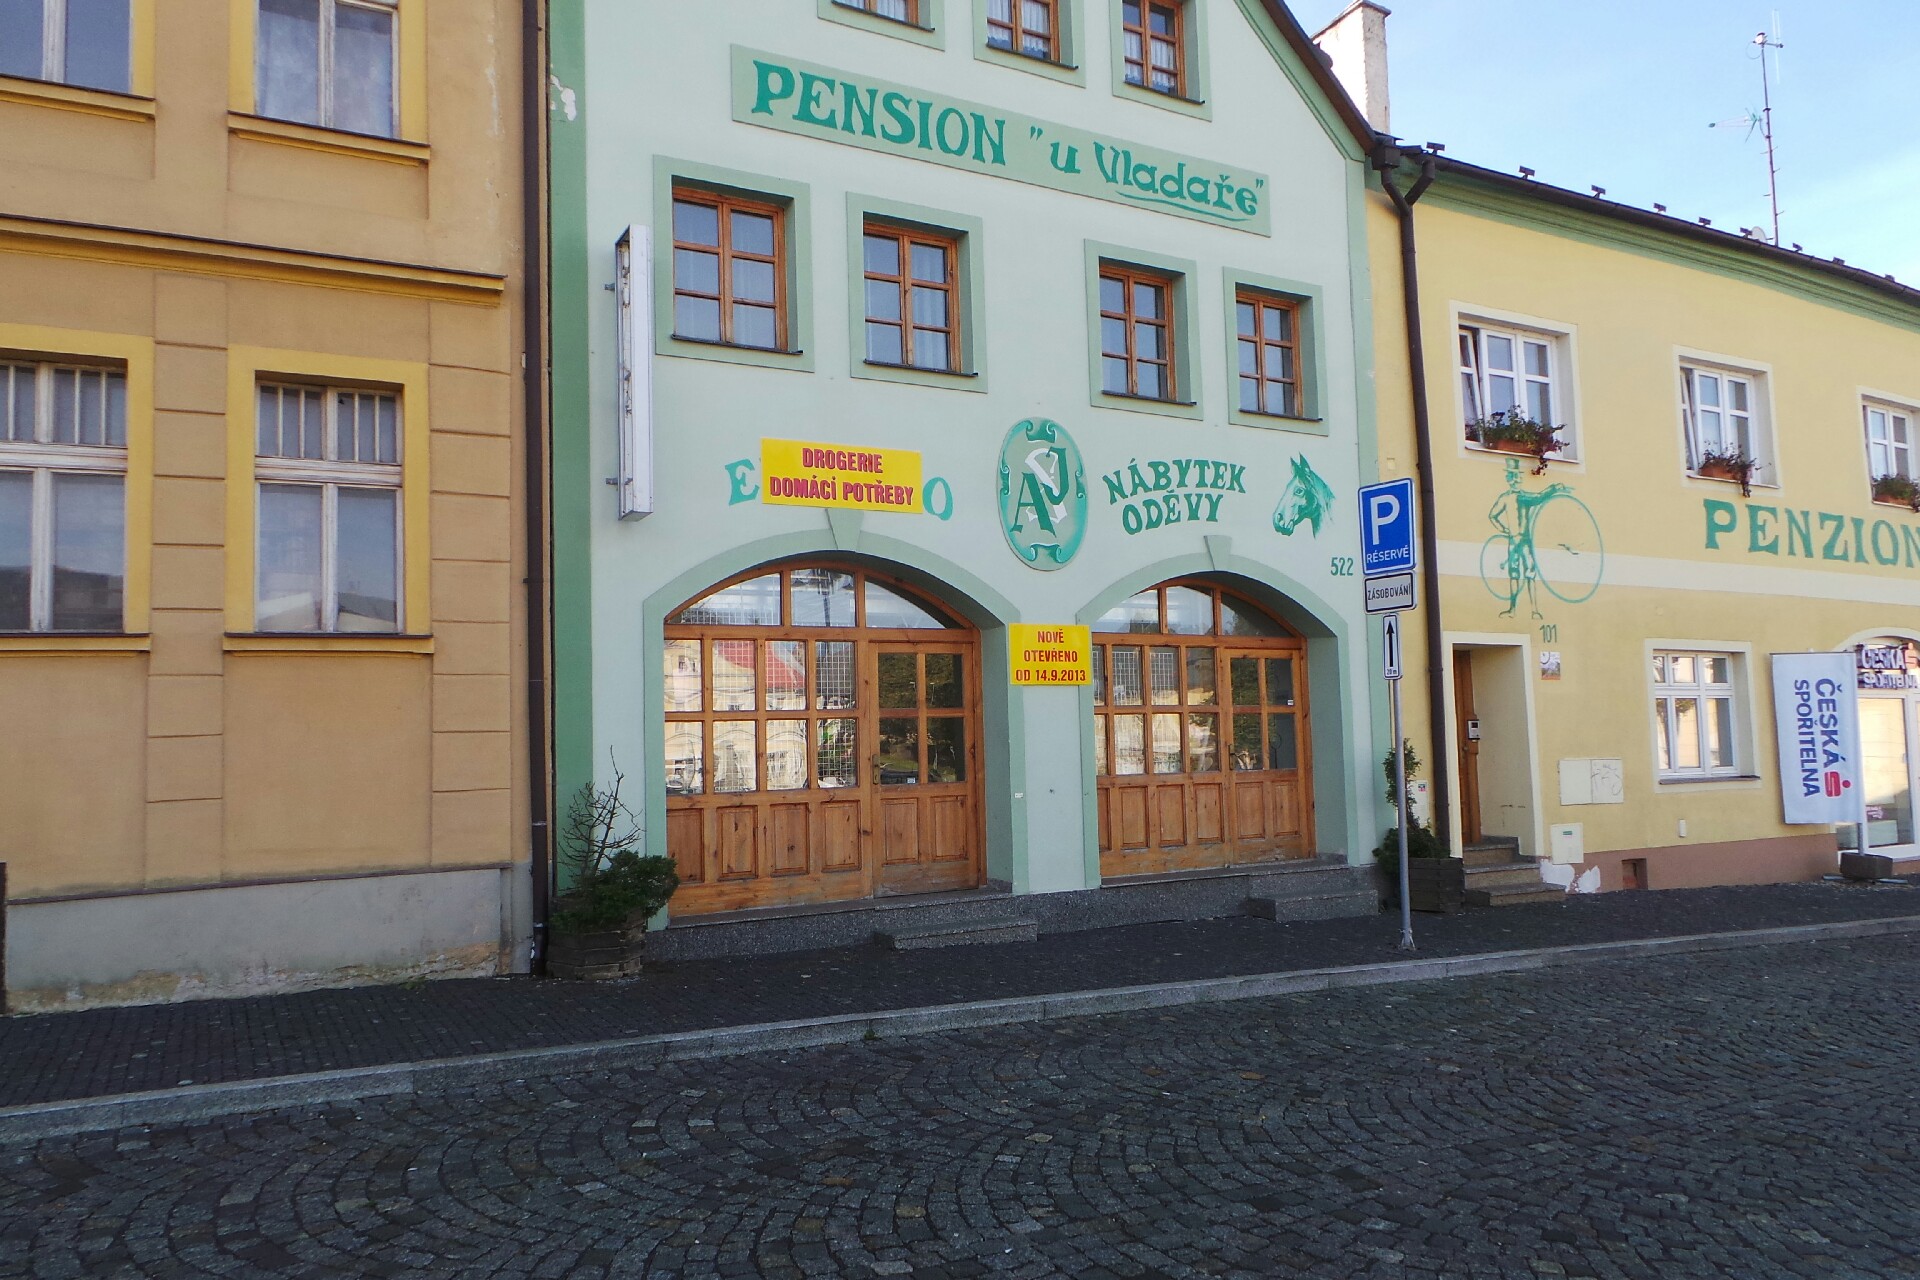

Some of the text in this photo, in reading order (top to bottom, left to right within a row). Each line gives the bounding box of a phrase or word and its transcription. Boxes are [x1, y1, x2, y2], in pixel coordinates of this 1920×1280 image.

[752, 60, 1006, 165] PENSION
[802, 447, 883, 474] DROGERIE
[769, 475, 914, 505] DOMÁCÍ POTŘEBY
[1101, 458, 1247, 505] NÁBYTEK
[1121, 491, 1224, 536] ODĚVY
[1370, 494, 1400, 546] P
[1703, 498, 1920, 569] PENZION
[1330, 557, 1354, 577] 522
[1366, 545, 1410, 563] RÉSERVÉ
[1367, 583, 1411, 601] ZÁSOBOVÁNÍ
[1037, 628, 1065, 643] NOVĚ
[1539, 624, 1558, 644] 101
[1023, 647, 1078, 663] OTEVŘENO
[1015, 669, 1086, 682] OD 14.9.2013
[1815, 678, 1846, 769] ČESKÁ
[1794, 679, 1821, 797] SPOŘITELNA
